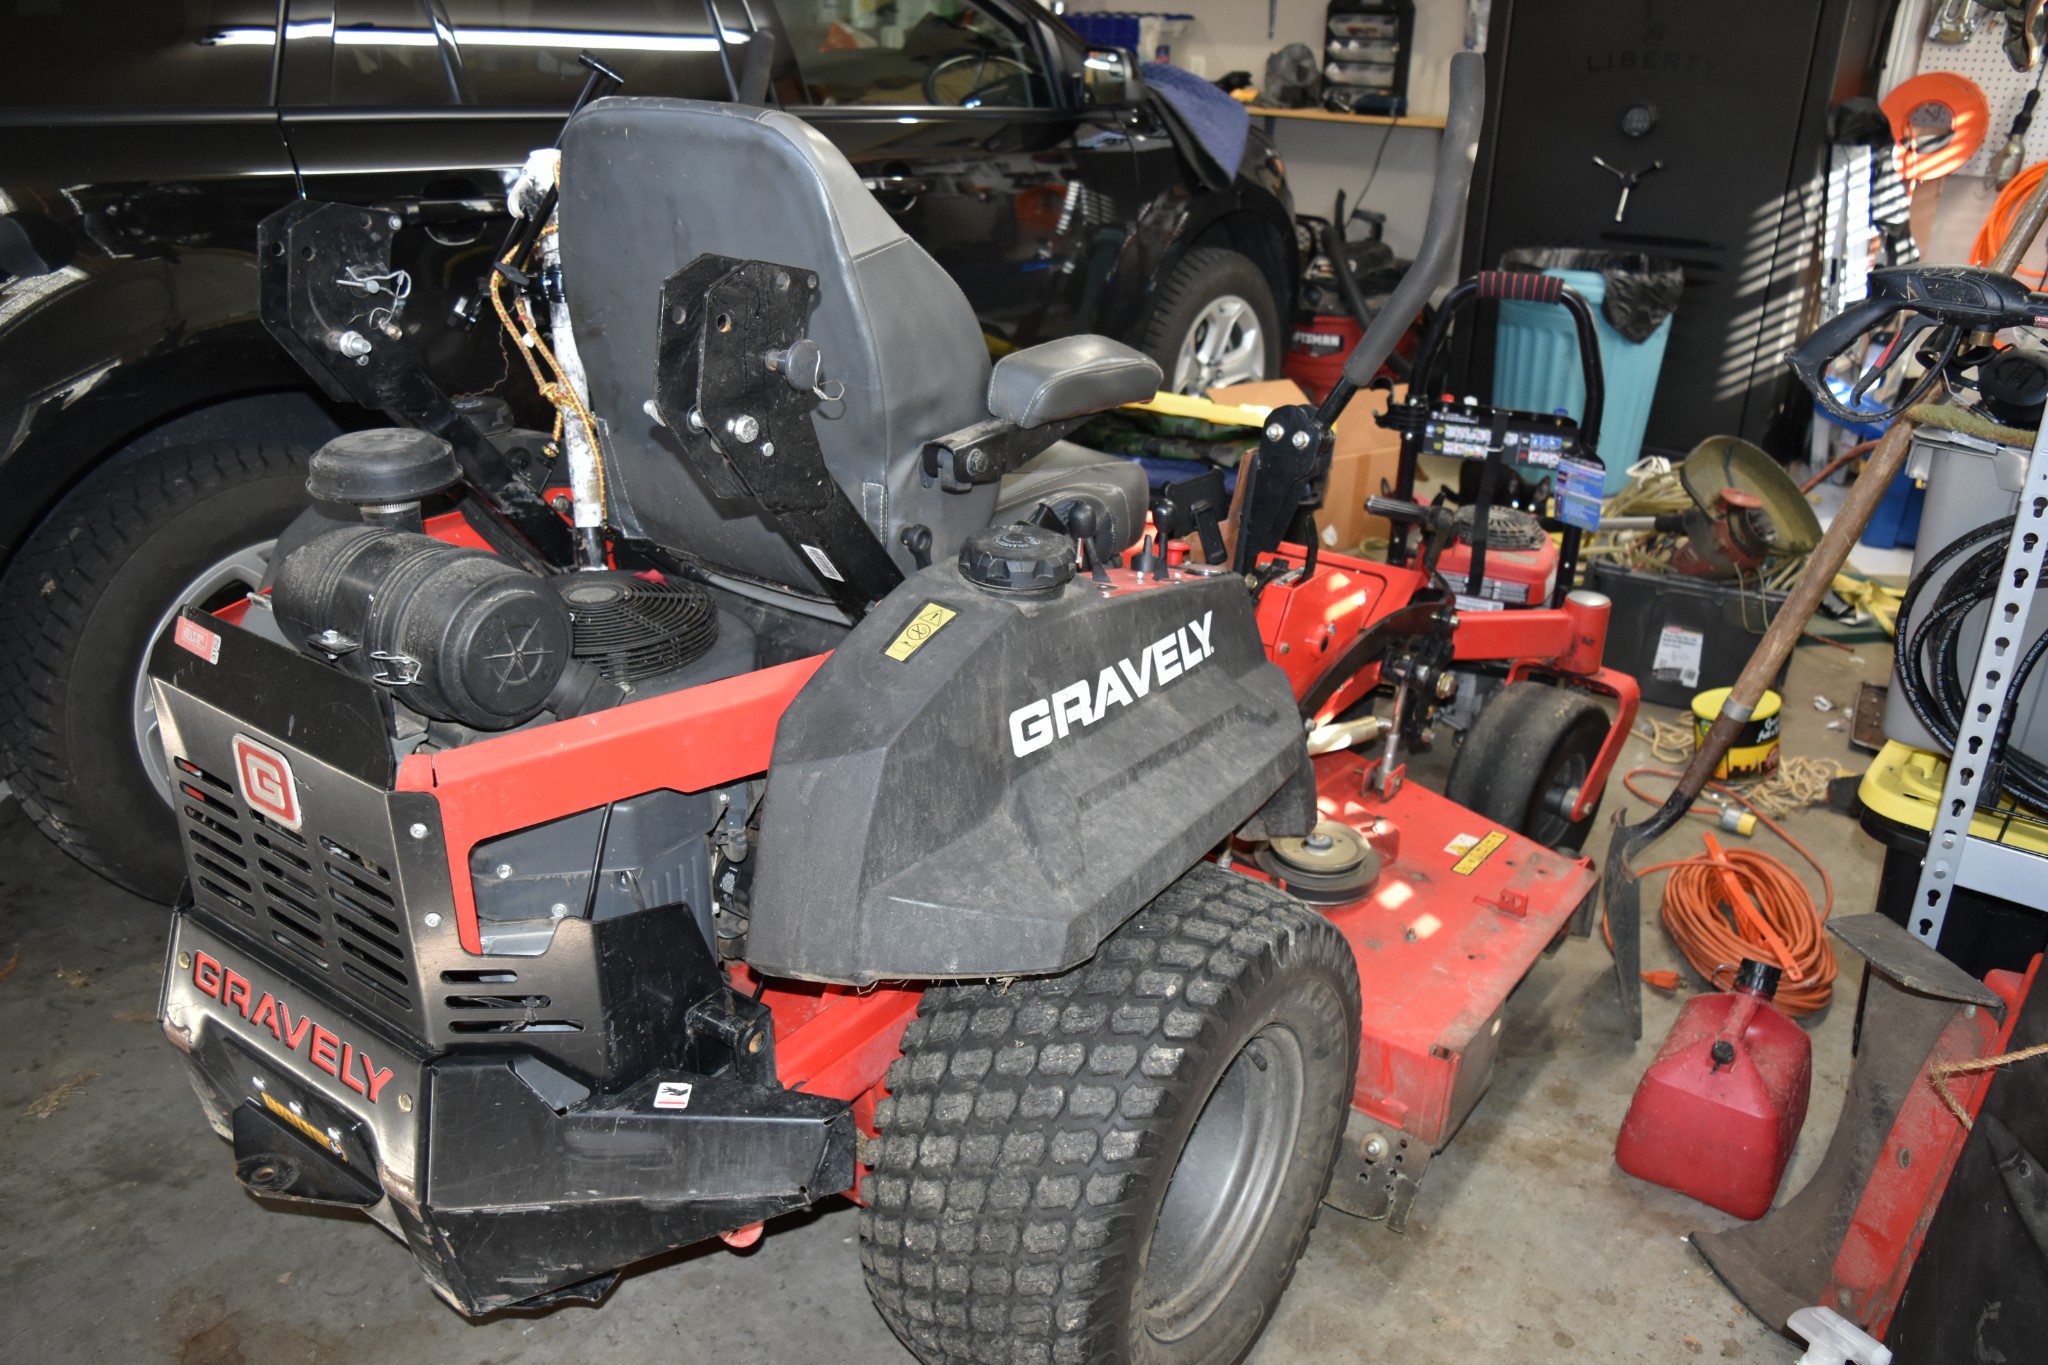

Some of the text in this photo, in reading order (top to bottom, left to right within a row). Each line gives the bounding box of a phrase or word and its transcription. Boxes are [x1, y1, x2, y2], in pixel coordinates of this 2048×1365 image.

[1587, 50, 1720, 79] LIBERTY
[1009, 610, 1213, 758] GRAVELY
[194, 951, 394, 1104] GRAVELY
